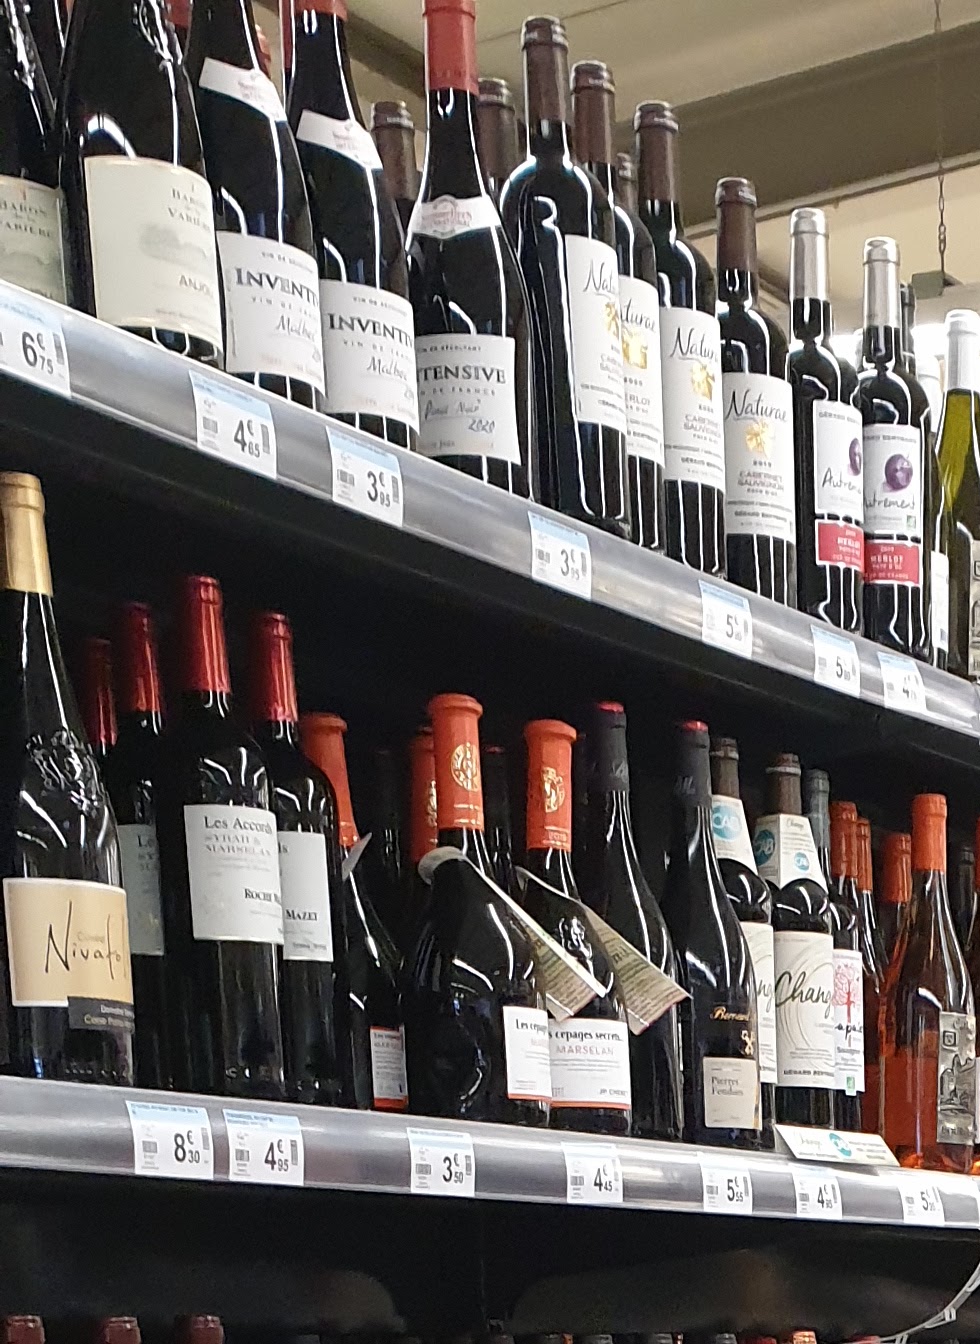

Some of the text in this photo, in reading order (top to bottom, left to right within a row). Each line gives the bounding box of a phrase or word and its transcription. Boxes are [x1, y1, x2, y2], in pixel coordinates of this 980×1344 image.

[725, 389, 788, 423] Naturae
[204, 815, 228, 830] Les
[173, 1130, 200, 1164] 8€30
[263, 1138, 288, 1172] 4€95
